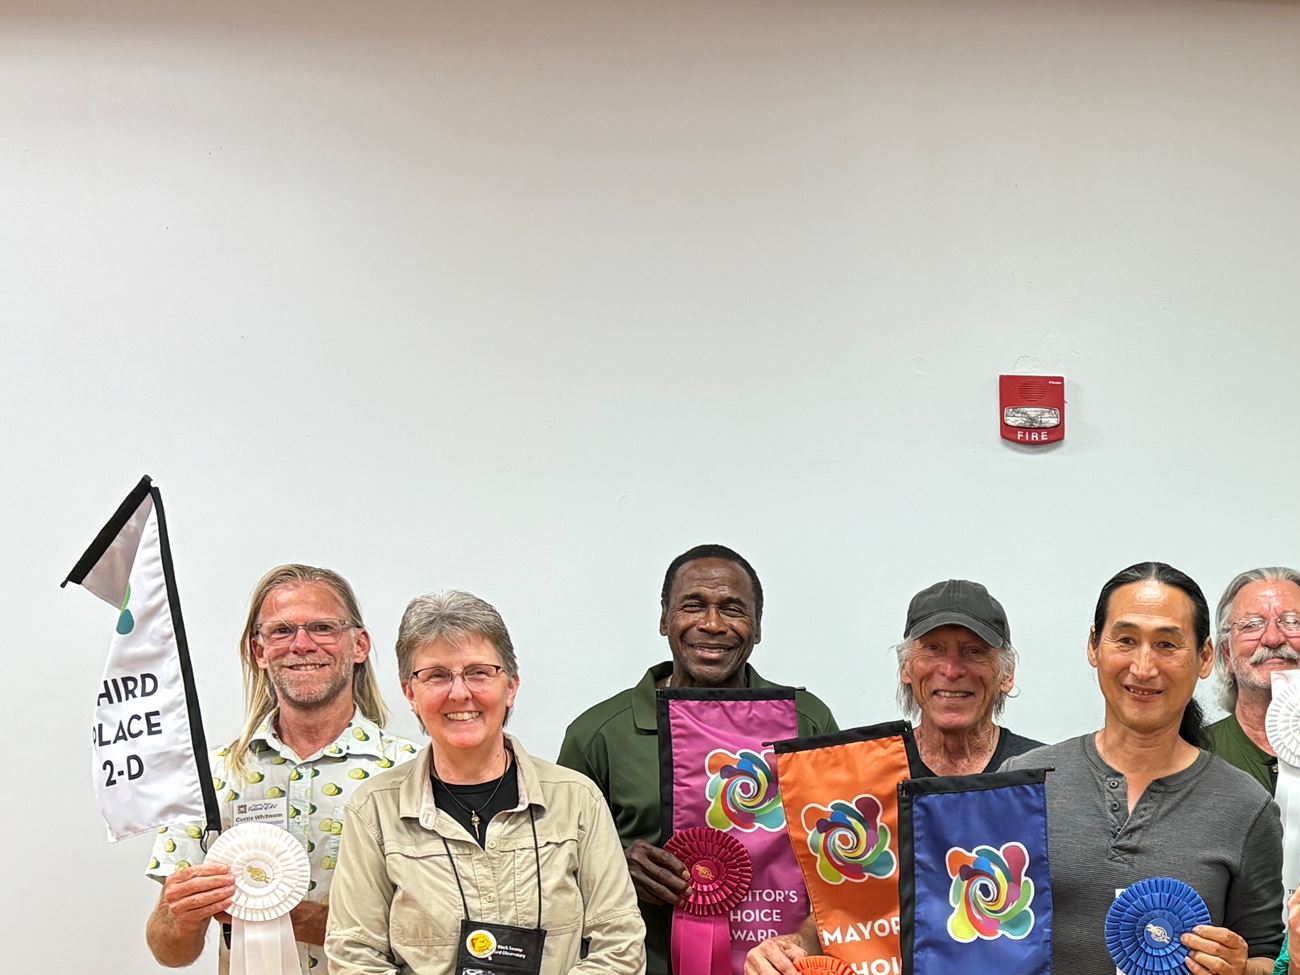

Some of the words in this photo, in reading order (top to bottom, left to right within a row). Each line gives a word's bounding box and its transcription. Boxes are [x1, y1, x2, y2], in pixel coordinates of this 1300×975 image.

[1017, 431, 1048, 440] FIRE
[97, 673, 158, 706] HIRD
[102, 754, 144, 787] 2-D
[730, 909, 782, 922] HOICE
[730, 929, 779, 942] WARD
